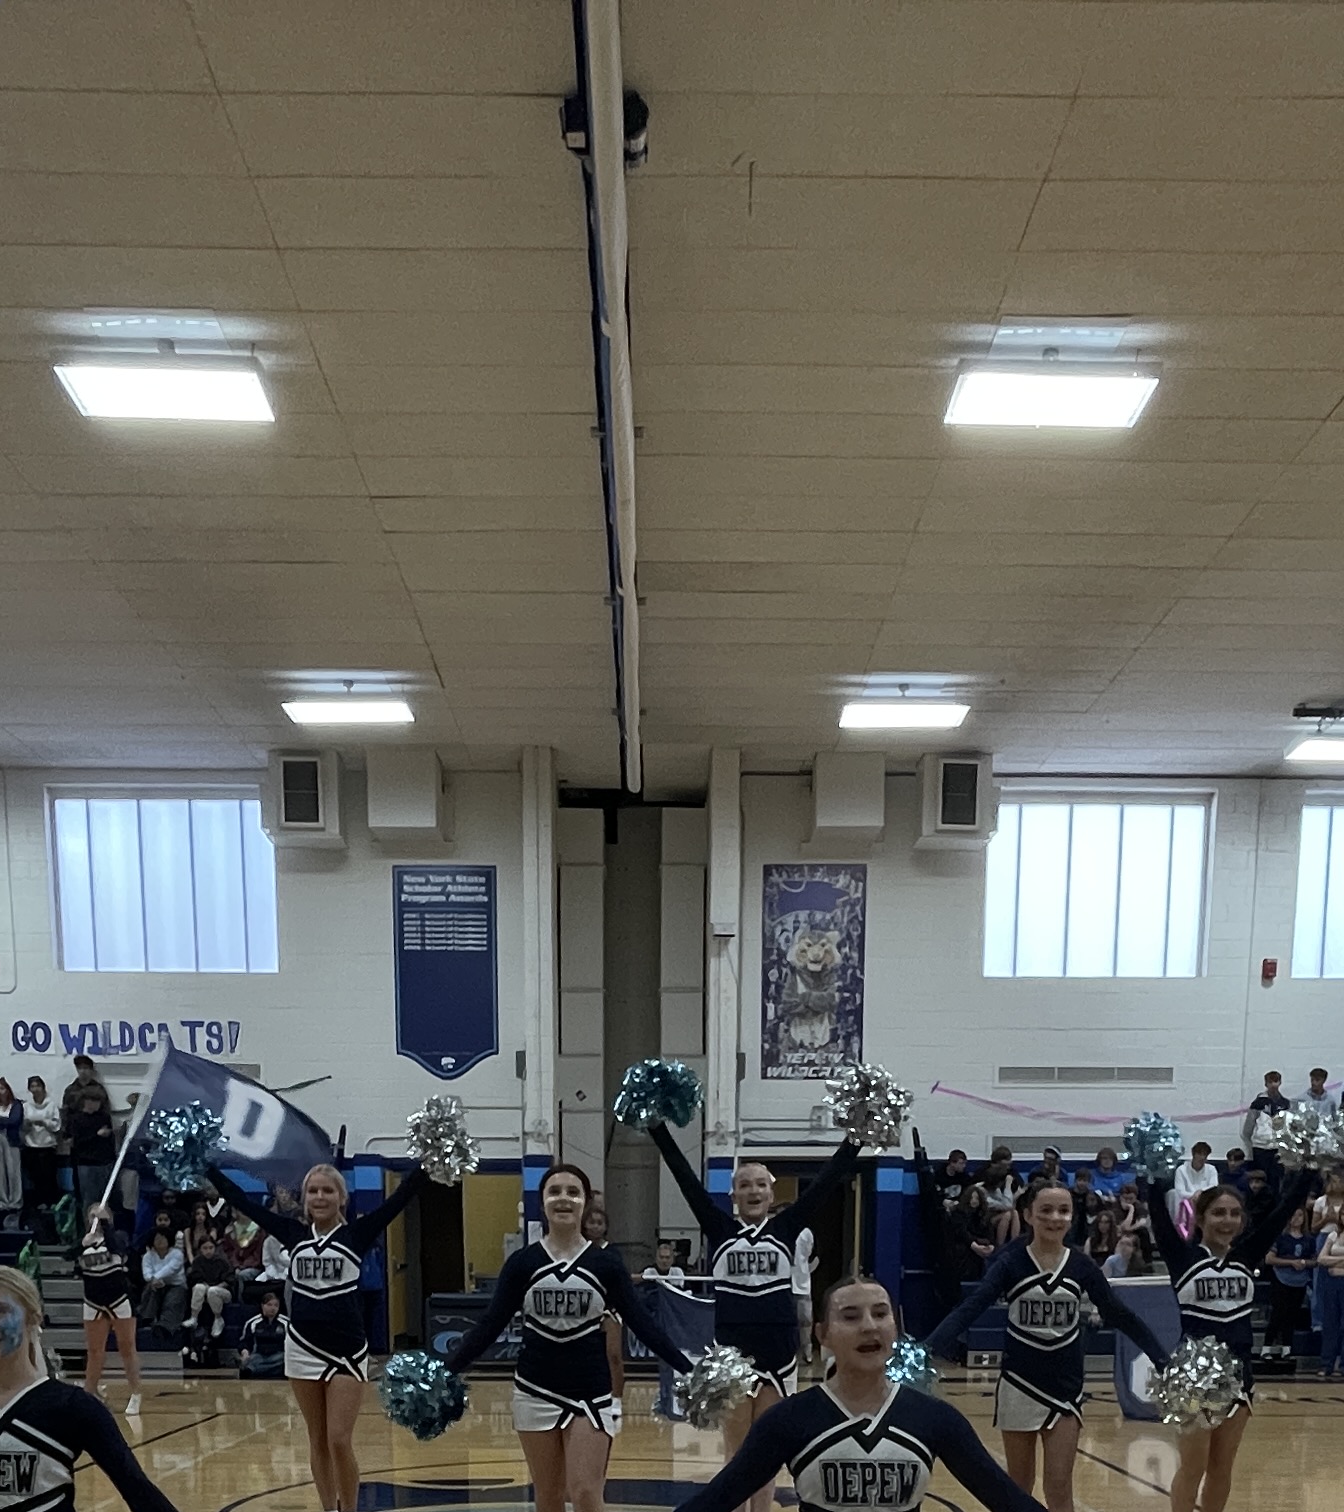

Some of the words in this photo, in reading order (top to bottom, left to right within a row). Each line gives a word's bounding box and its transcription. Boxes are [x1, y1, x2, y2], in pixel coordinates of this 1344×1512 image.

[456, 875, 486, 883] State
[401, 894, 446, 903] Program
[448, 894, 488, 902] Awards
[11, 1020, 52, 1053] GO
[219, 1078, 286, 1160] D
[296, 1256, 344, 1281] DEPEW
[726, 1250, 779, 1276] DEPEW
[1195, 1277, 1248, 1300] DEPEW
[531, 1287, 594, 1319] DEPEW
[1018, 1299, 1077, 1327] DEPEW
[819, 1458, 921, 1507] DEPEW
